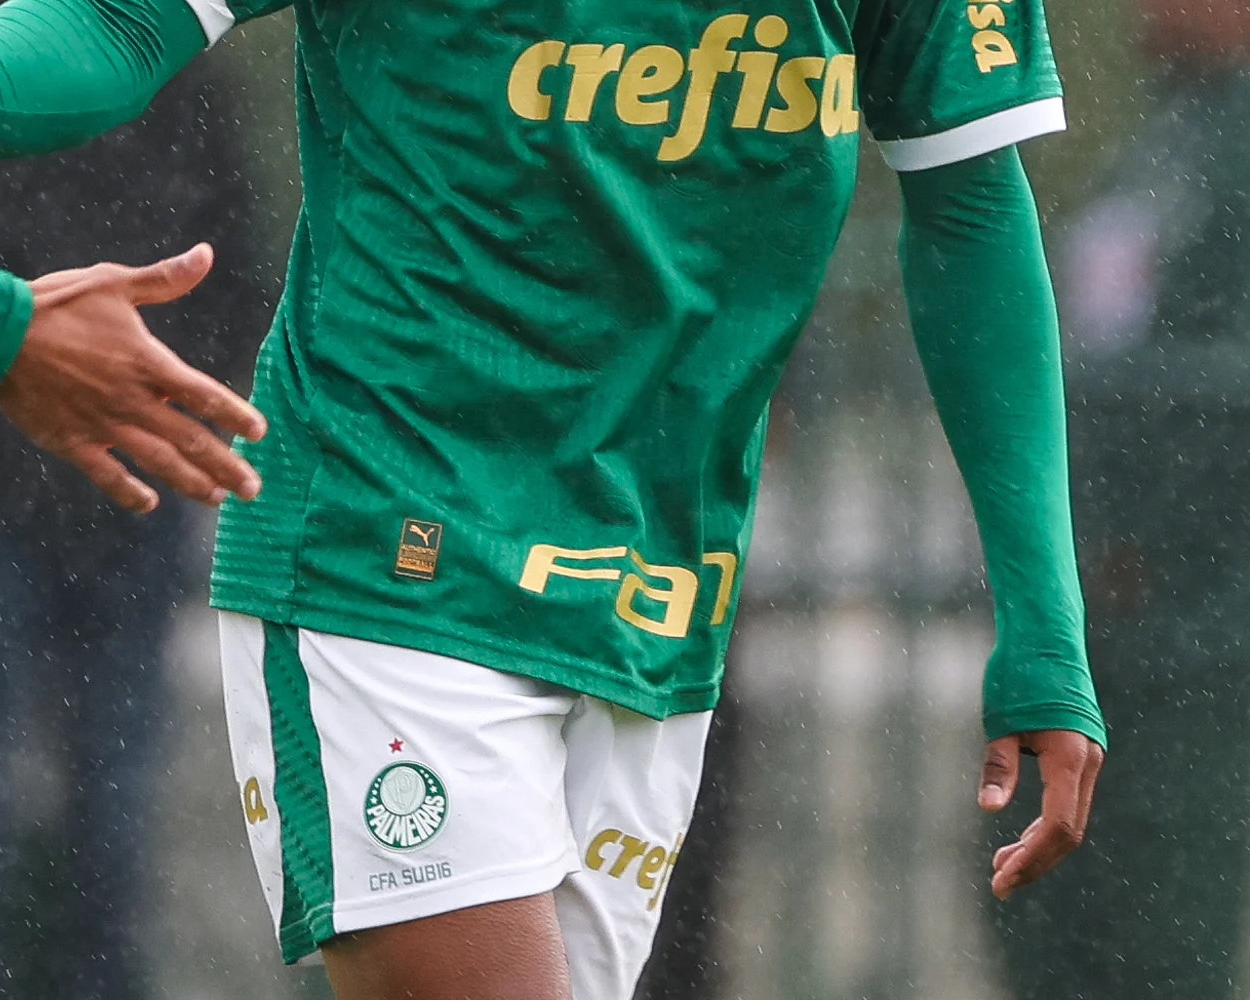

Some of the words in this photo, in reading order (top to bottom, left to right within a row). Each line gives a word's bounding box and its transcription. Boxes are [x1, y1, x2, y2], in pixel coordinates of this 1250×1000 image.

[506, 13, 860, 162] crefisa
[367, 795, 446, 847] PALMEIRAS
[369, 872, 399, 892] CFA
